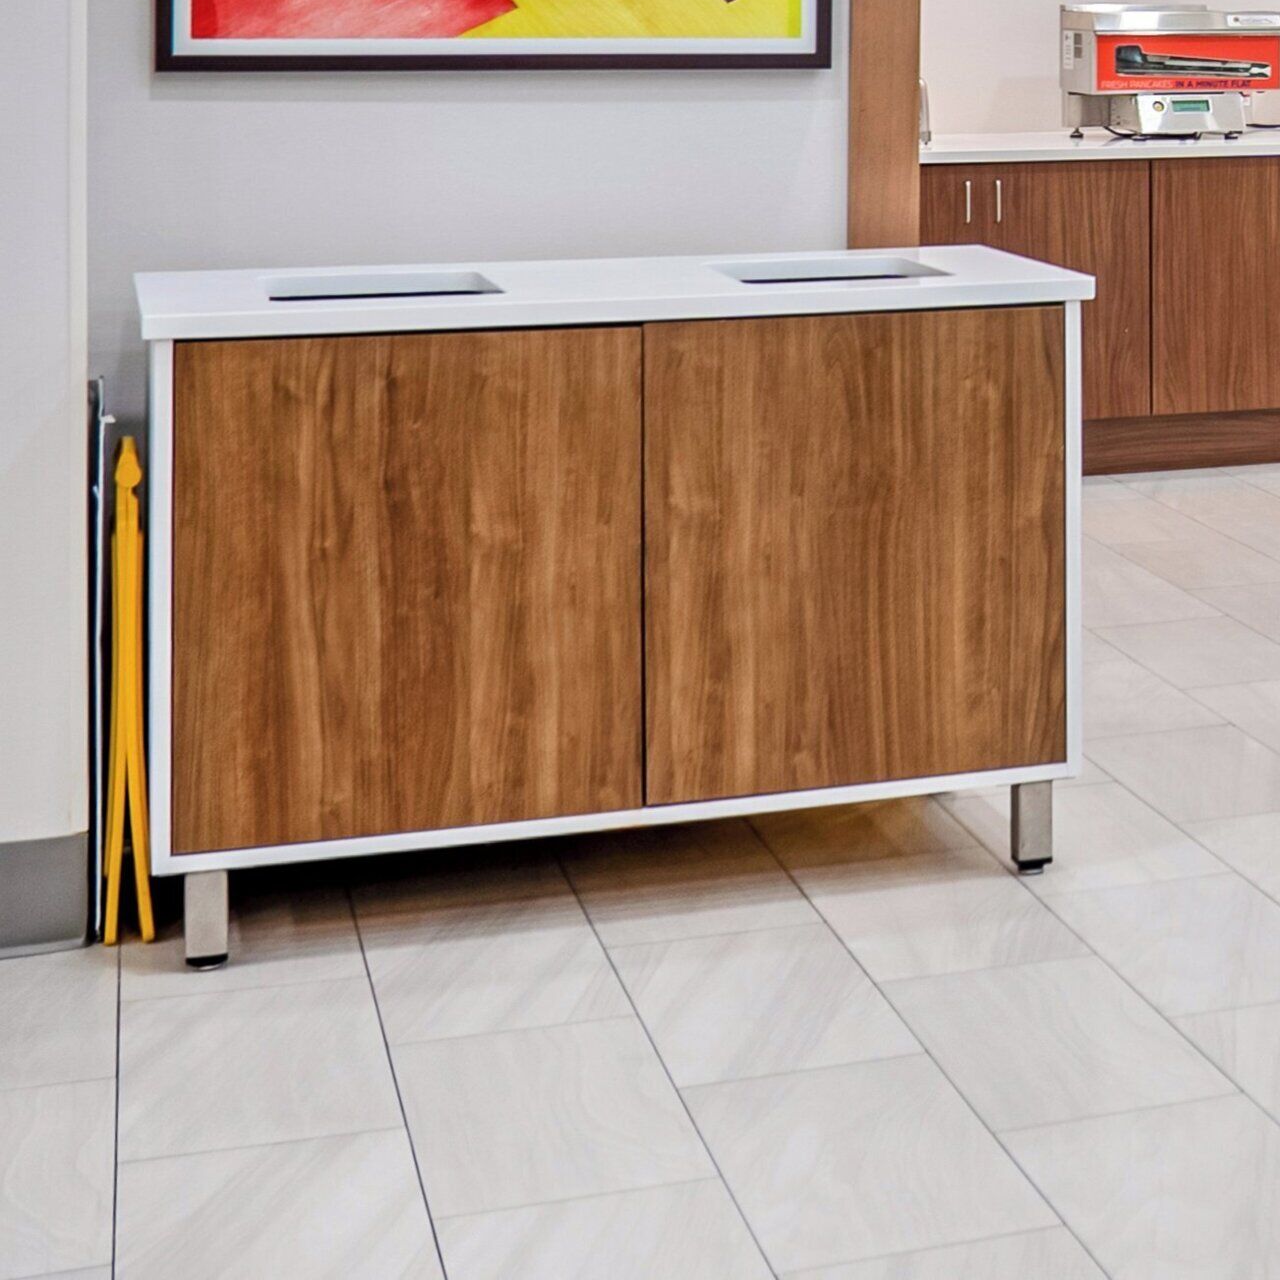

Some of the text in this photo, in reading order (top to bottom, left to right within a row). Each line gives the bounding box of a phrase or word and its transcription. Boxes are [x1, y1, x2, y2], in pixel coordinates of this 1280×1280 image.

[1101, 80, 1128, 89] FRESH
[1175, 80, 1185, 88] IN
[1196, 80, 1228, 88] MINUTE
[1231, 80, 1251, 88] FLAT
